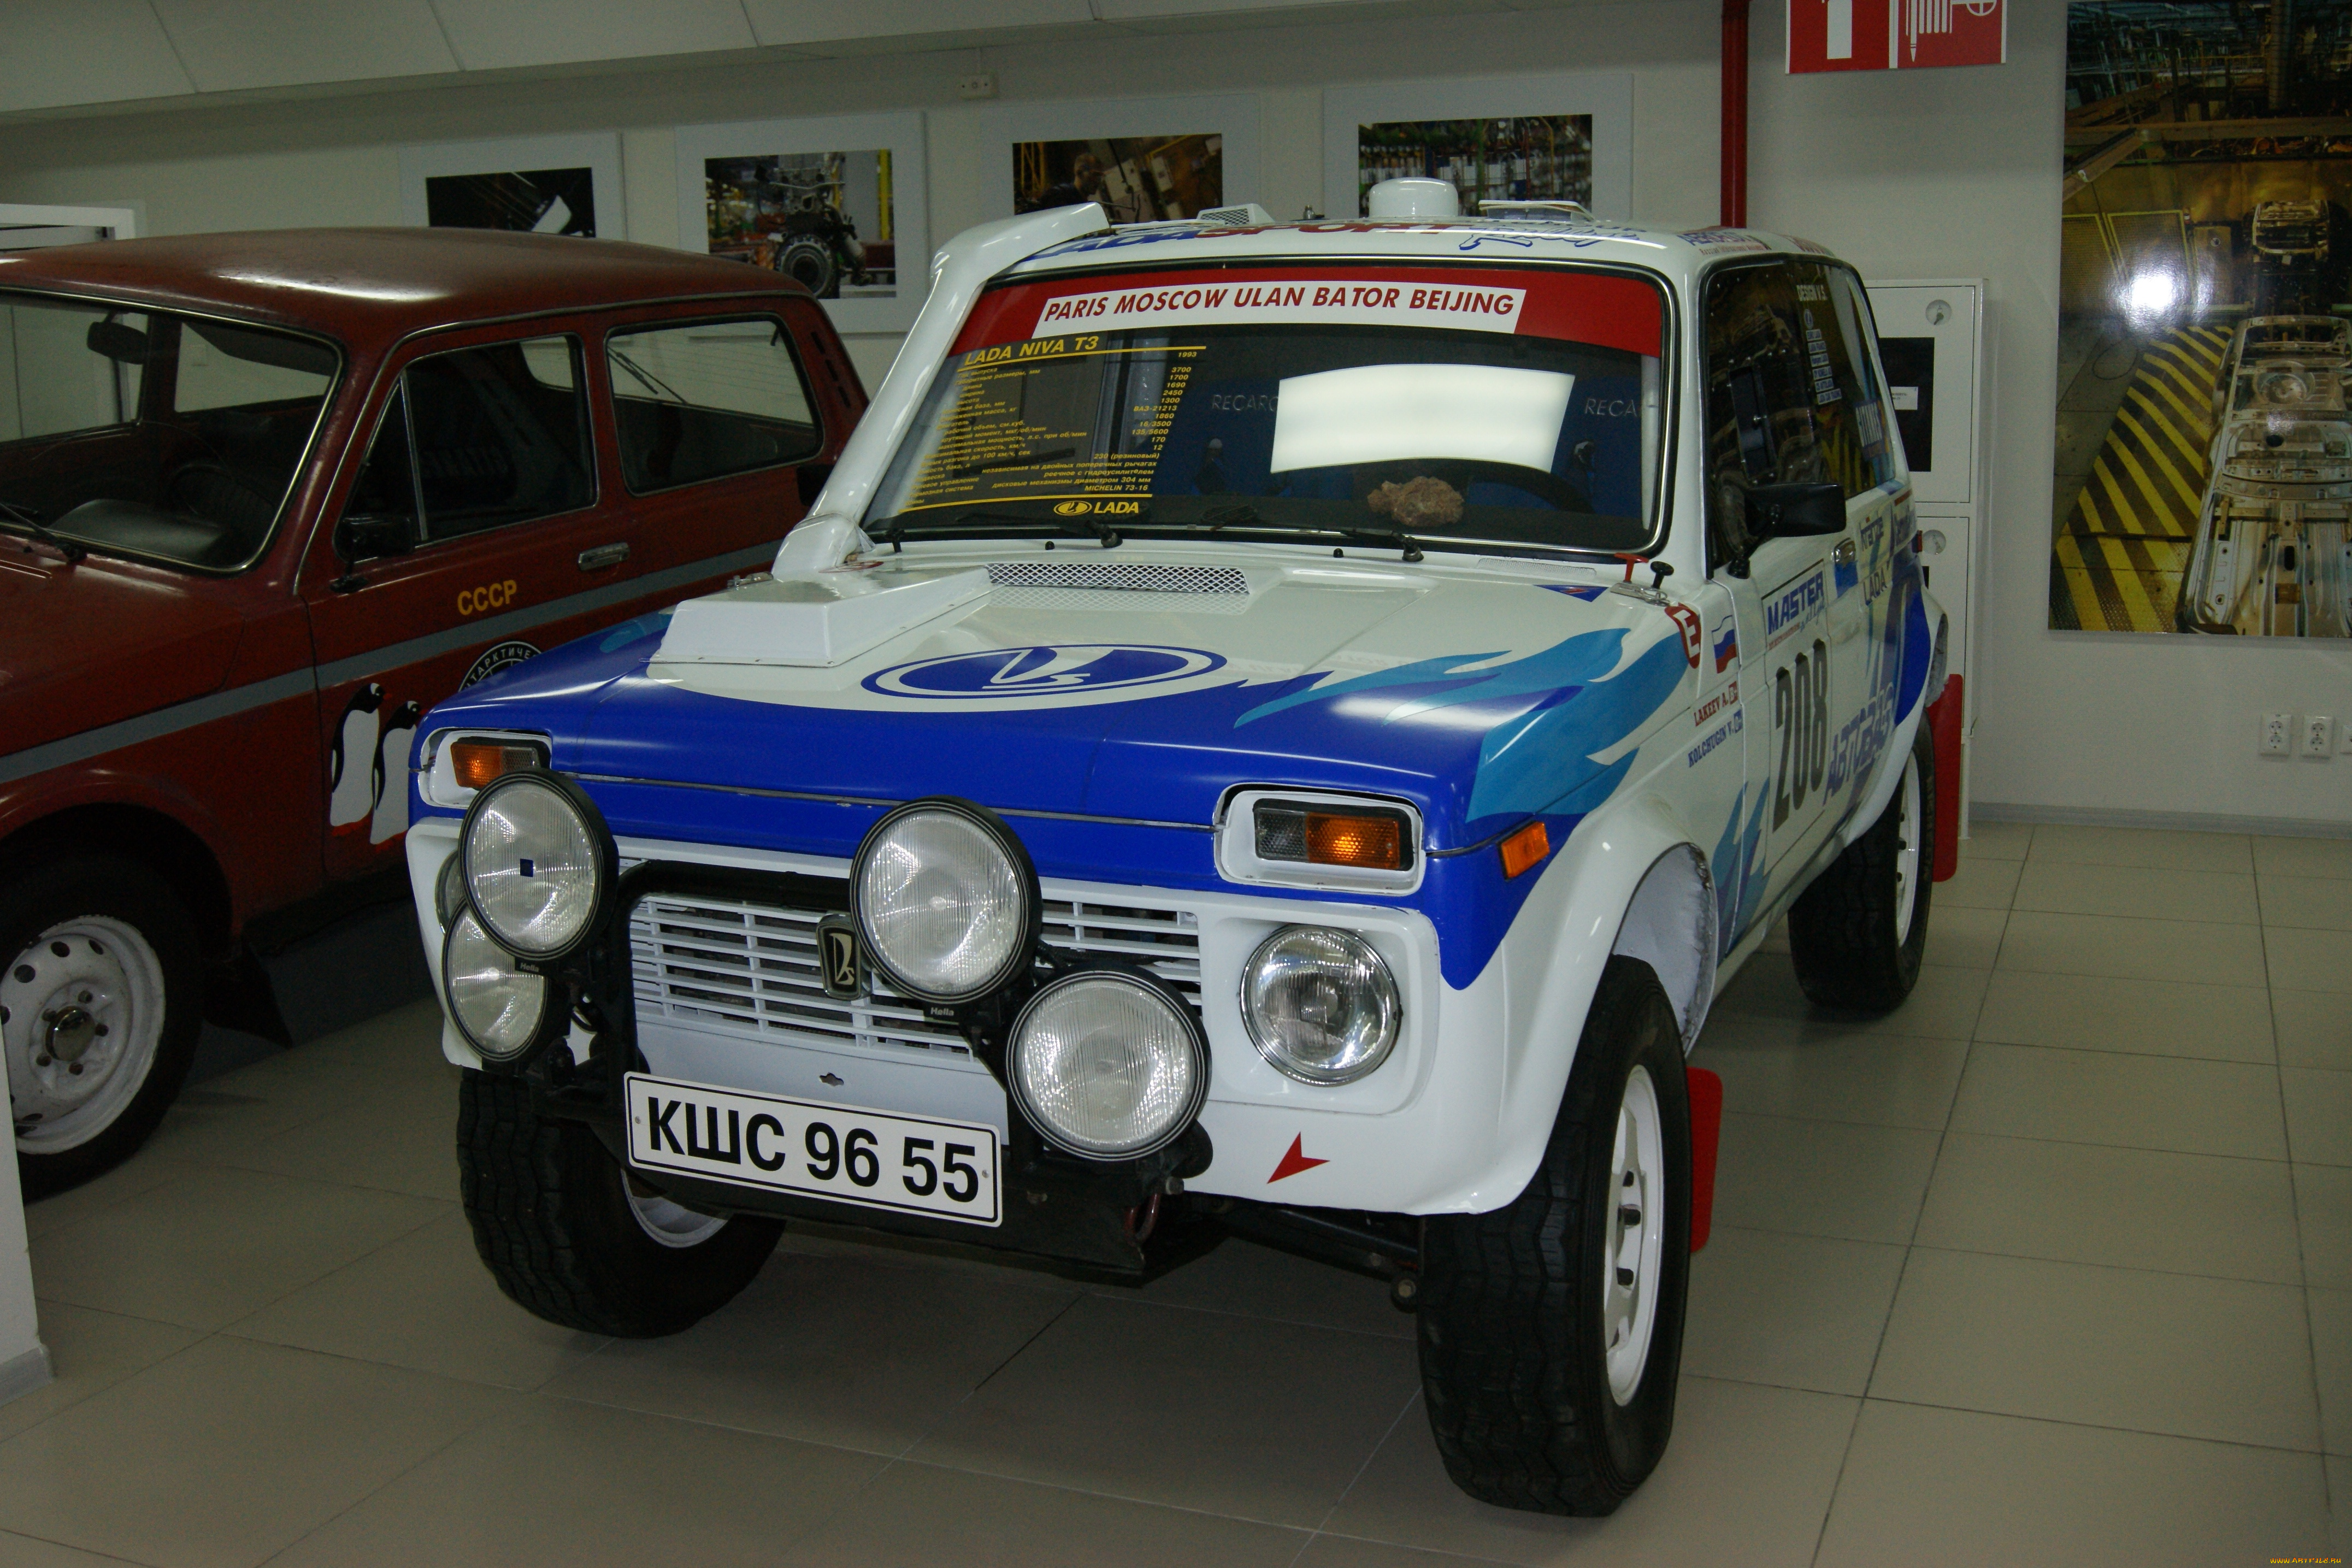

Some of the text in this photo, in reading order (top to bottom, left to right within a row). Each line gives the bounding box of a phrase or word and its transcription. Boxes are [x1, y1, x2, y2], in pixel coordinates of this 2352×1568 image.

[1044, 287, 1514, 321] PARIS MOSCOW ULAN BATOR BEIJING
[964, 336, 1099, 366] LADA NIVA T3
[1094, 501, 1139, 514] LADA
[457, 580, 517, 615] СССР
[1767, 570, 1824, 635] MASTER
[467, 647, 539, 687] ТАРКТИЧЕ
[1694, 695, 1720, 727] LAKEEV
[1773, 638, 1828, 834] 208
[520, 962, 539, 972] Hella
[930, 1006, 954, 1017] Hella
[648, 1097, 979, 1202] КШС 96 55
